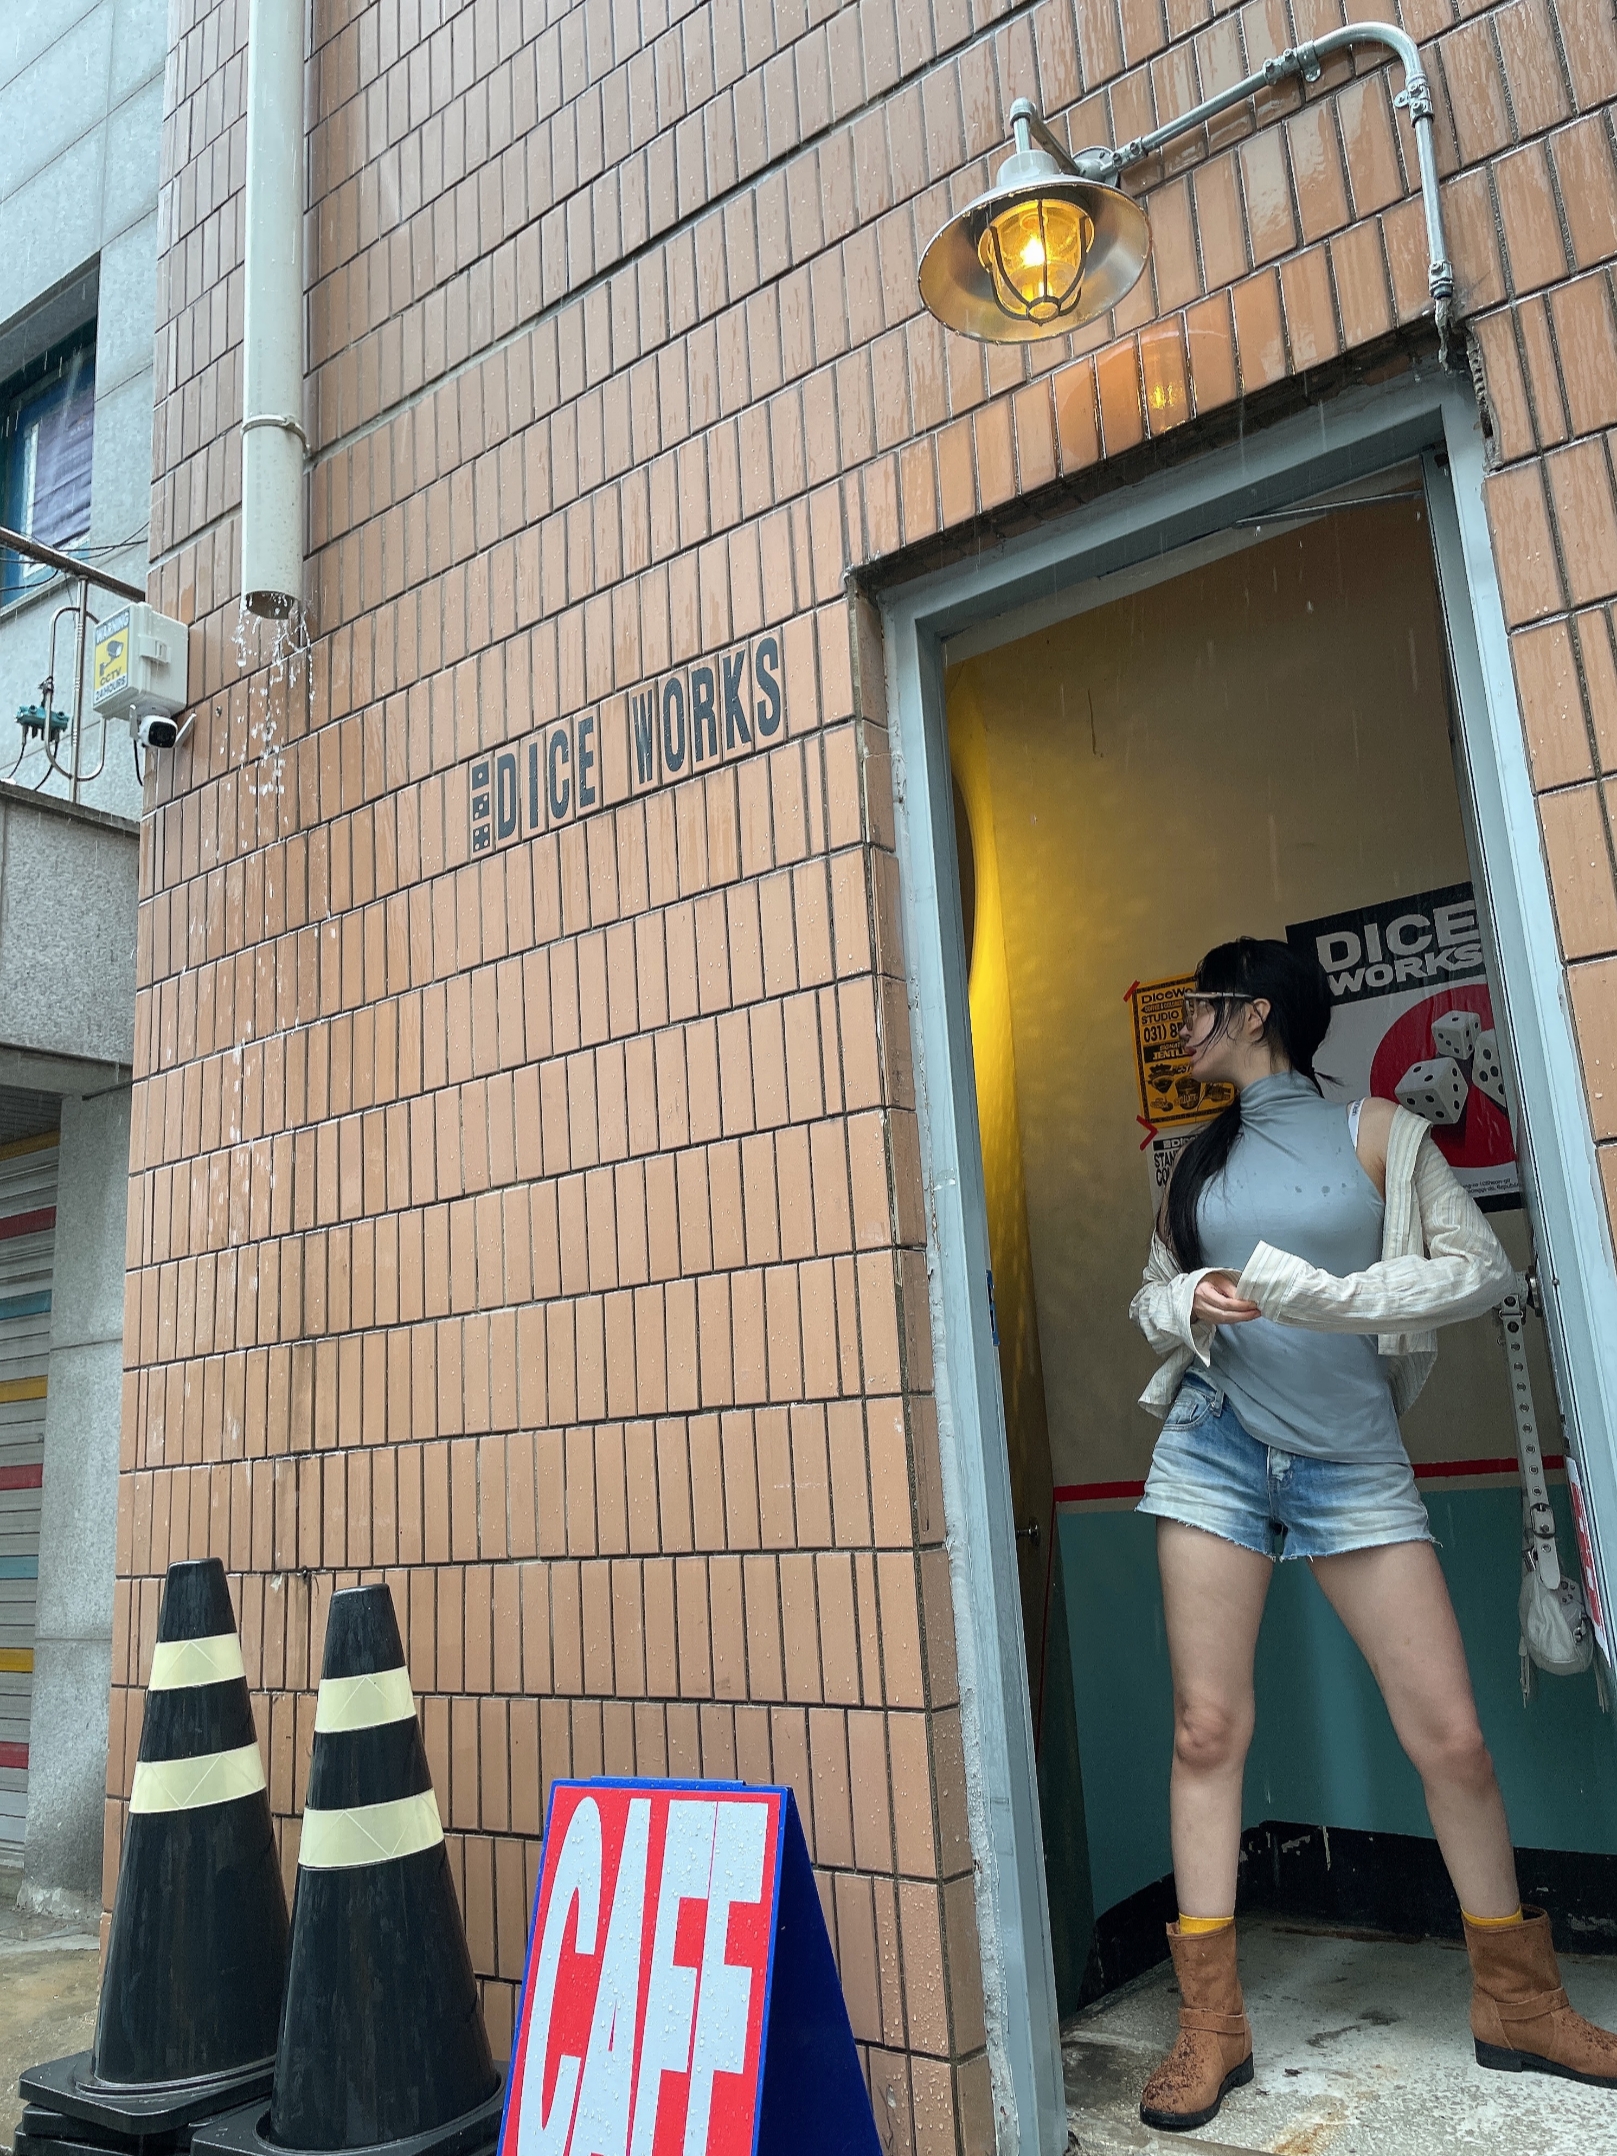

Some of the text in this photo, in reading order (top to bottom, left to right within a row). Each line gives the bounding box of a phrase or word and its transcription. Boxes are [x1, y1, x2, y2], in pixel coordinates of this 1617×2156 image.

[100, 667, 122, 686] CCTV
[496, 637, 782, 841] DICE WORKS
[1316, 900, 1481, 973] DICE
[1328, 943, 1484, 996] WORKS
[1141, 1010, 1179, 1025] STUDIO
[1143, 1025, 1167, 1043] 031)
